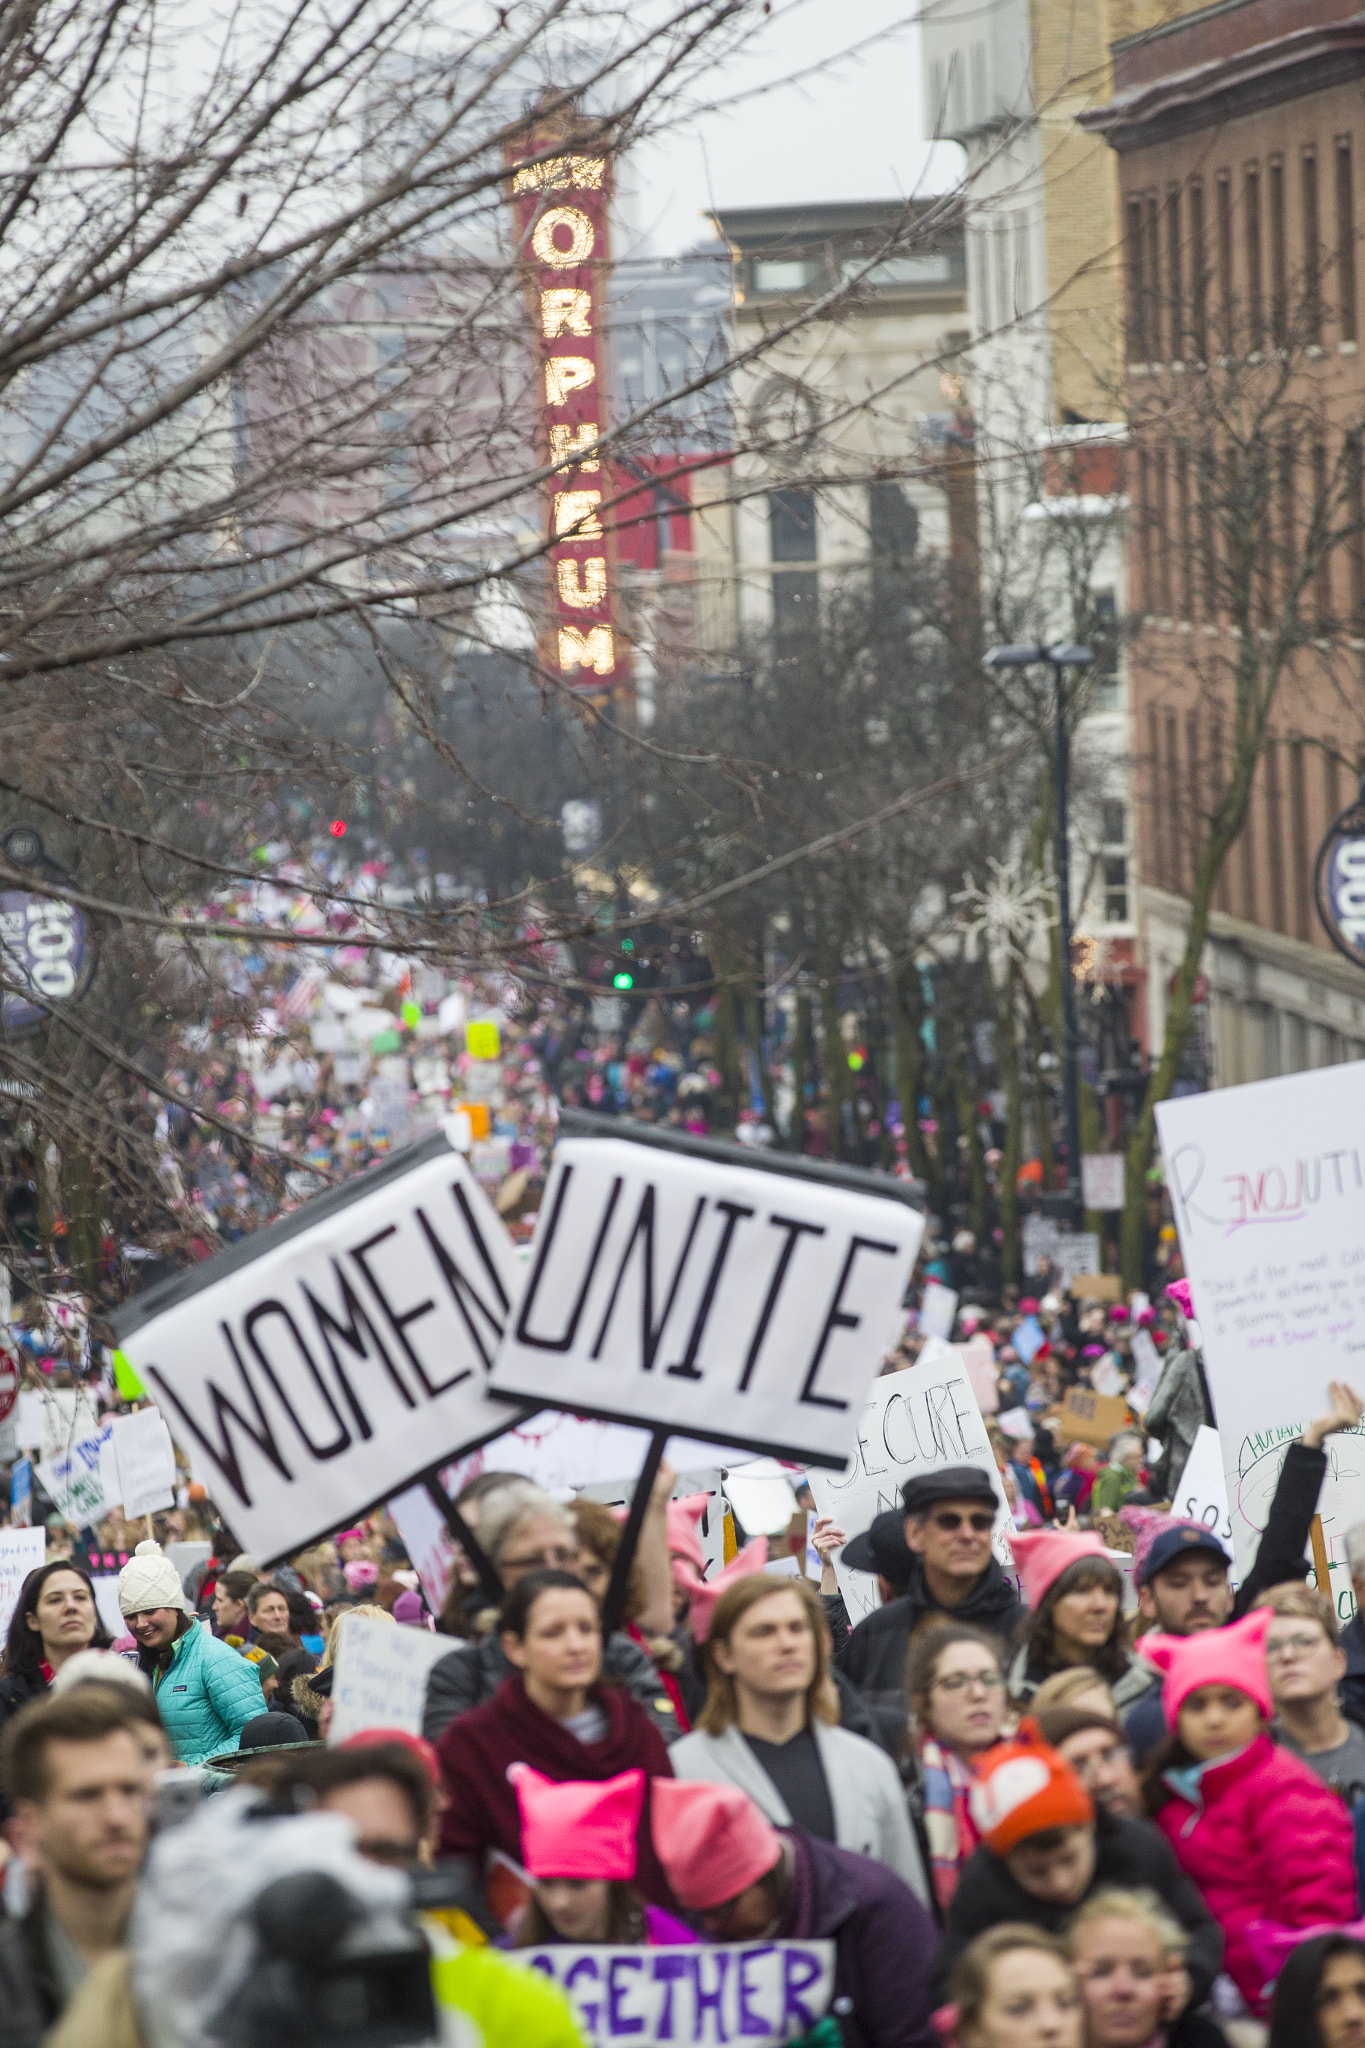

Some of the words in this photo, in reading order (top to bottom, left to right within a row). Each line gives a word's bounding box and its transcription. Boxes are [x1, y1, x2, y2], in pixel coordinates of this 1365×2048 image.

[532, 206, 616, 675] ORPHEUM
[26, 901, 76, 997] 100
[148, 1182, 510, 1507] WOMEN
[516, 1165, 898, 1410] UNITE
[530, 1943, 824, 2043] GETHER
